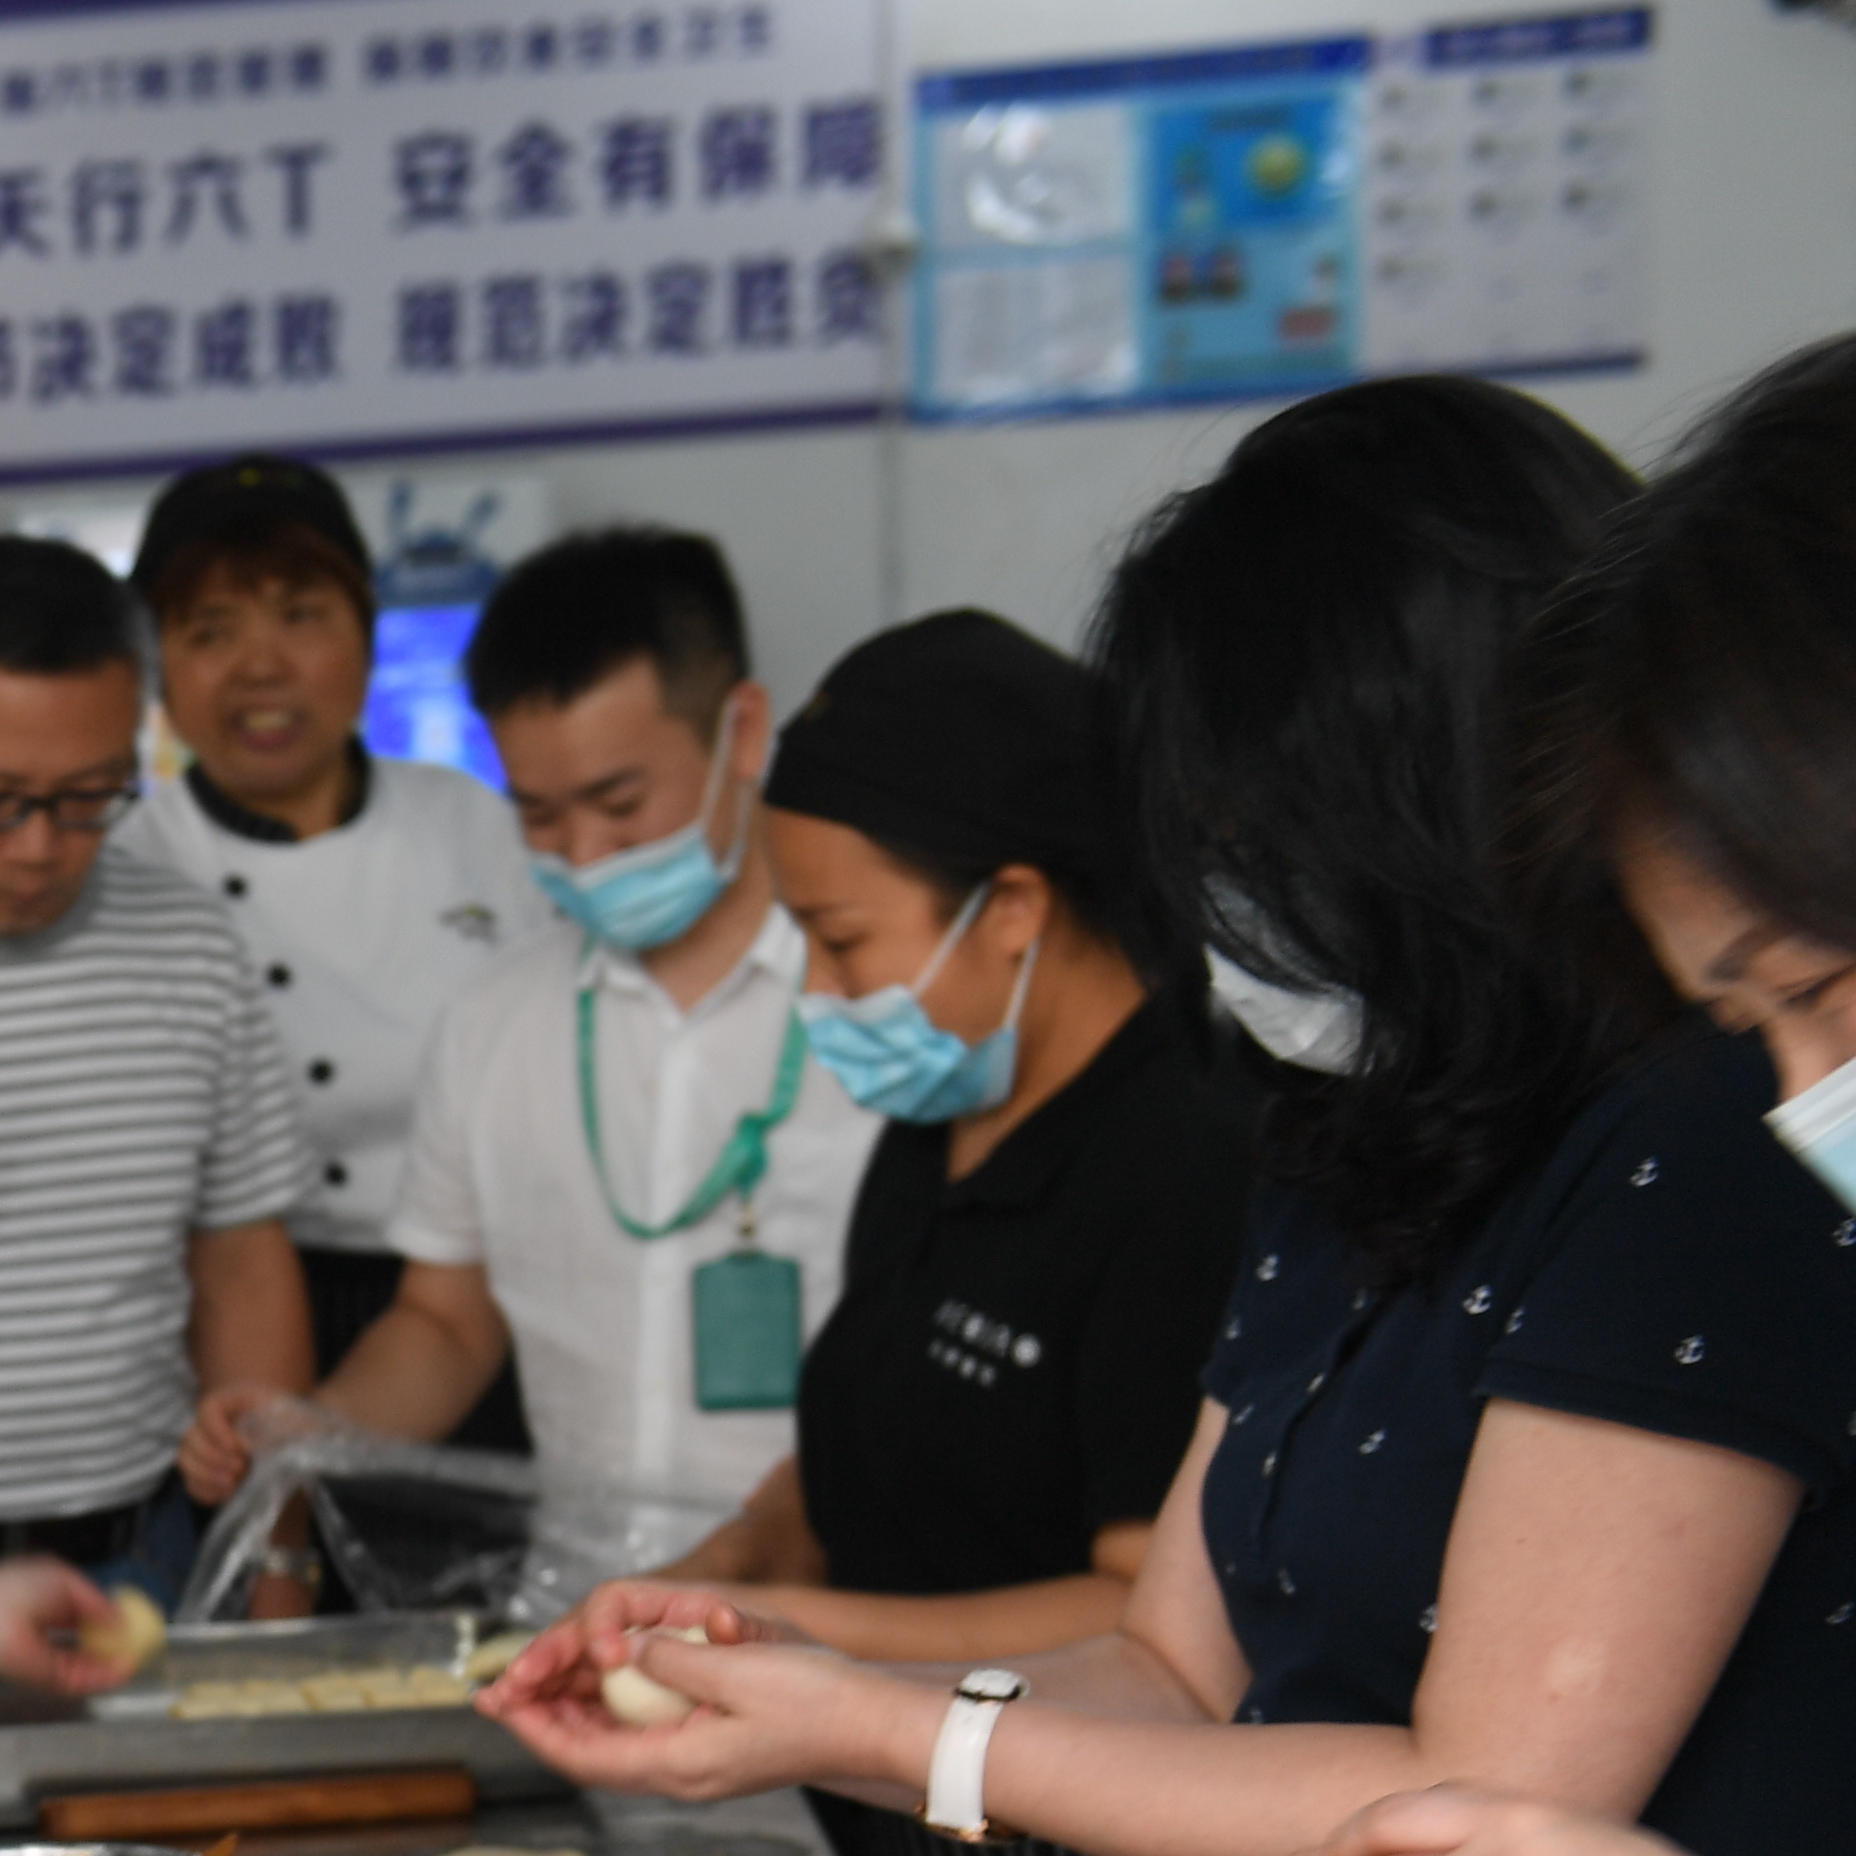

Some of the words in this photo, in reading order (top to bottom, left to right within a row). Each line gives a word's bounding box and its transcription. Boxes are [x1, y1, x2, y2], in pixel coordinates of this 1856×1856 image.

[392, 94, 884, 230] 安全有保障
